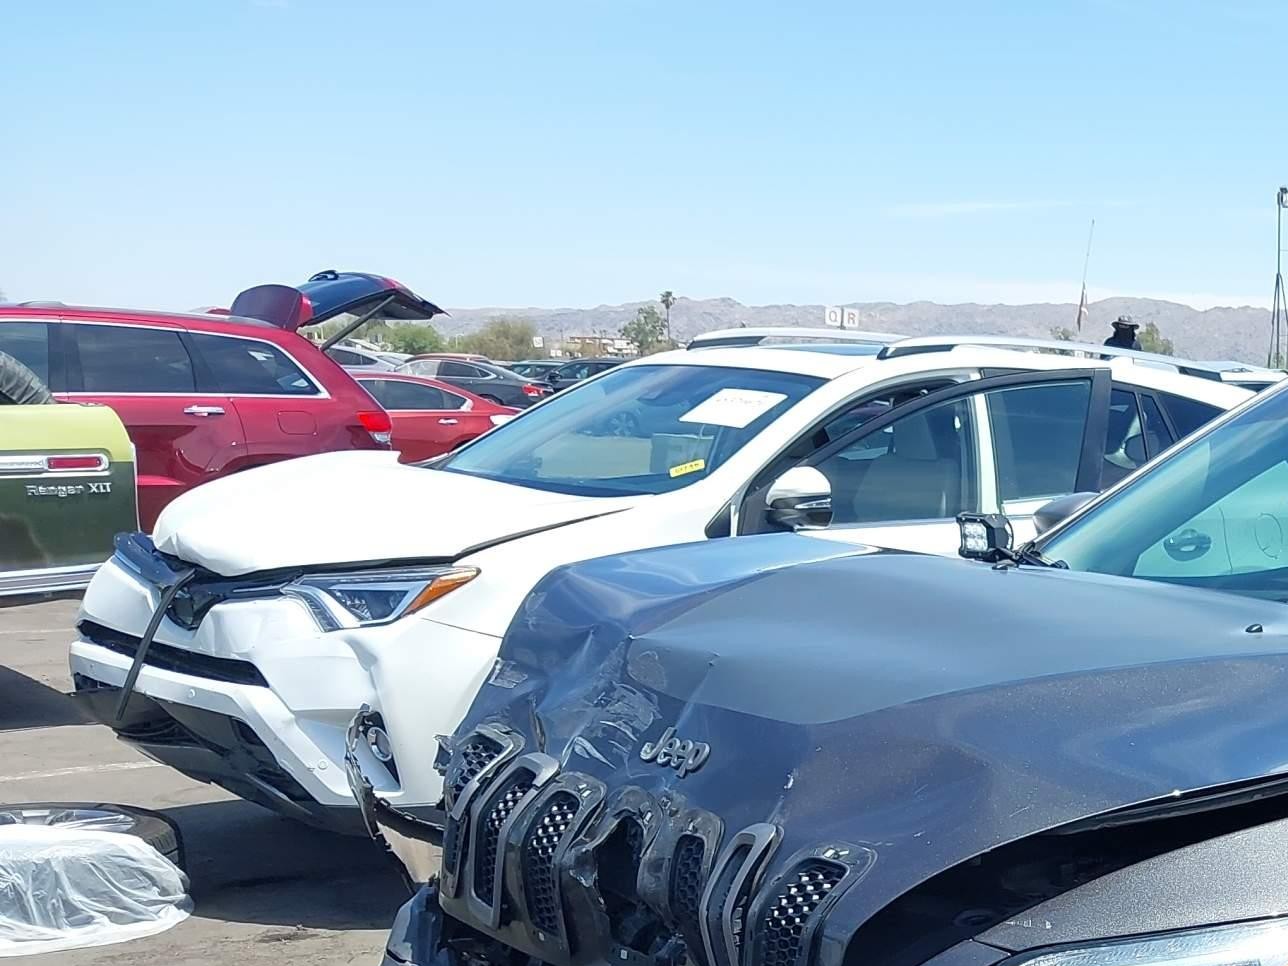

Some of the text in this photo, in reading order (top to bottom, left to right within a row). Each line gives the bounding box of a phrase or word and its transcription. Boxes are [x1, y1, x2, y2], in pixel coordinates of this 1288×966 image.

[25, 482, 112, 497] Ranger XLT
[640, 726, 711, 779] Jeep
